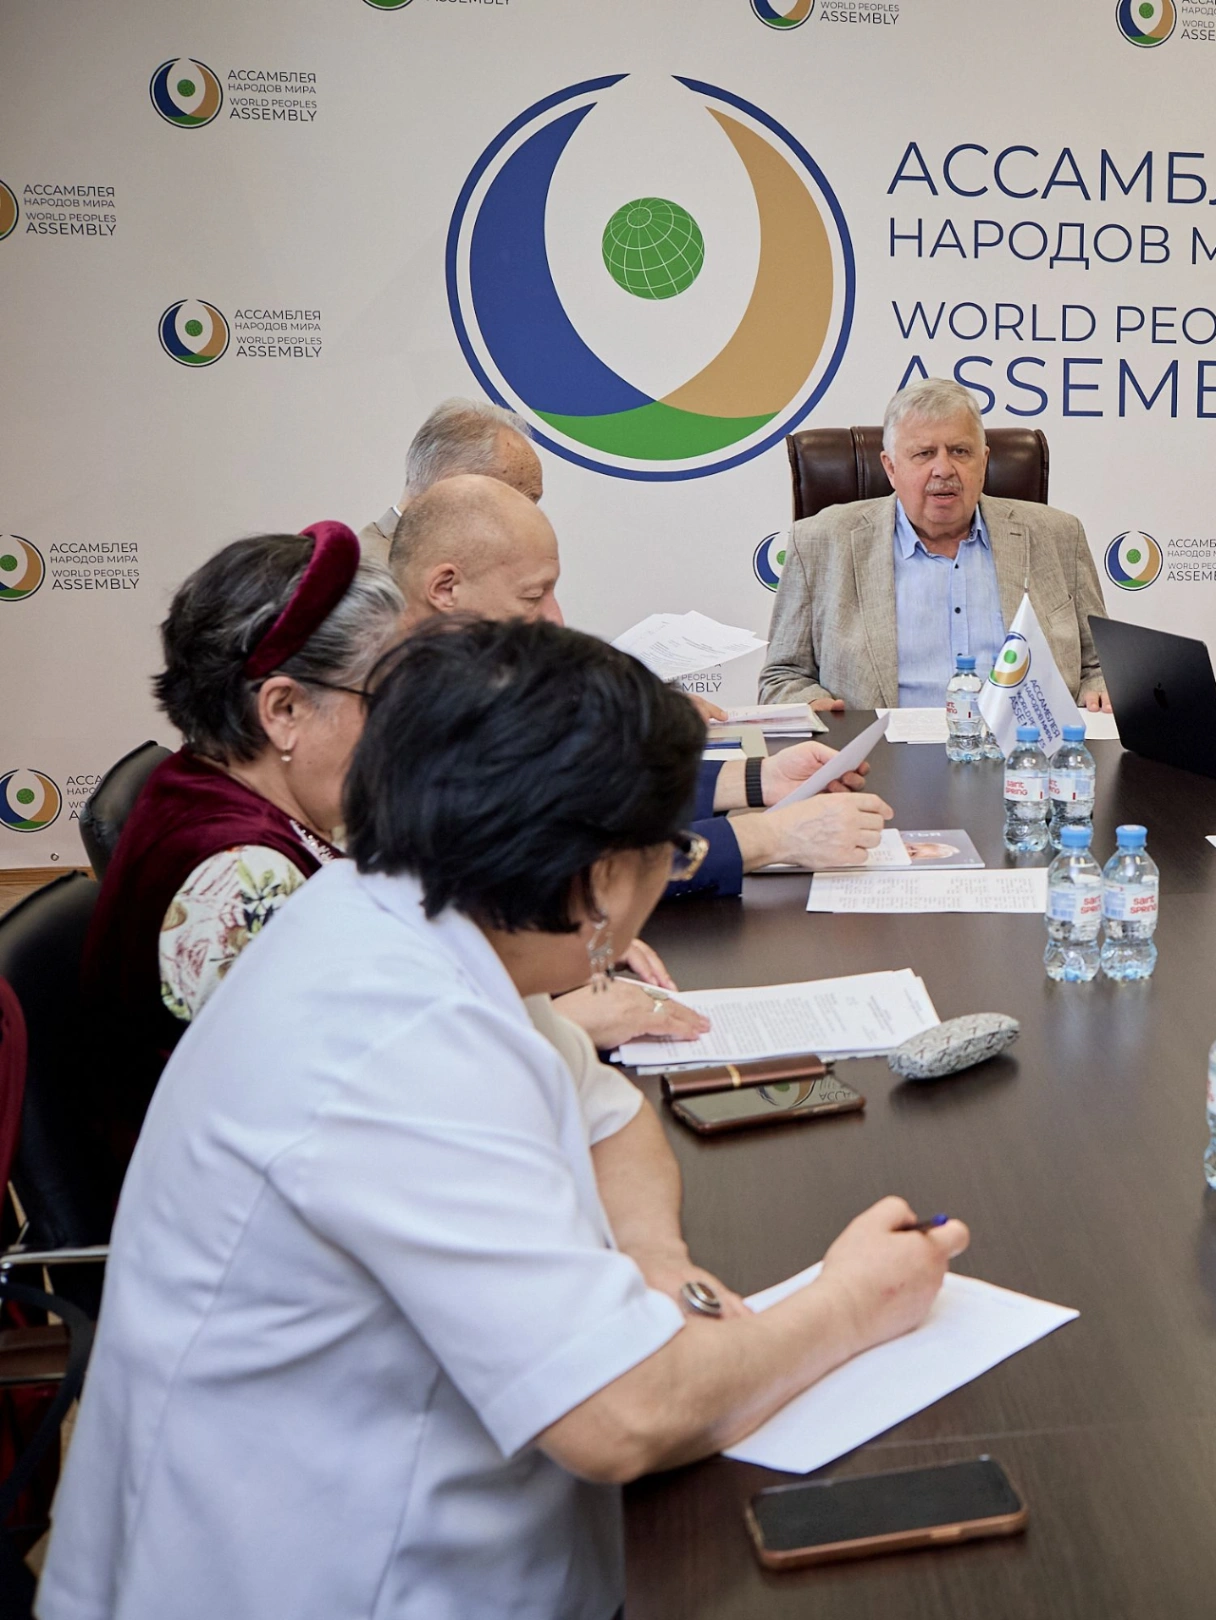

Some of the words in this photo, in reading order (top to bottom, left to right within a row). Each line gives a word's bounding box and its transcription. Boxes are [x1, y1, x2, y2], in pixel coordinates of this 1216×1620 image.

[820, 1, 856, 11] WORLD
[858, 2, 900, 13] PEOPLES
[819, 10, 900, 26] ASSEMBLY
[1181, 19, 1215, 29] WORLD
[227, 69, 317, 84] АССАМБЛЕЯ
[227, 82, 283, 94] НАРОДОВ
[284, 84, 317, 95] МИРА
[229, 97, 270, 108] WORLD
[271, 98, 318, 109] PEOPLES
[228, 106, 318, 122] ASSEMBLY
[22, 183, 116, 198] АССАМБЛЕЯ
[23, 197, 81, 208] НАРОДОВ
[82, 199, 116, 209] МИРА
[25, 212, 67, 222] WORLD
[68, 213, 117, 223] PEOPLES
[25, 221, 117, 237] ASSEMBLY
[889, 217, 1171, 271] НАРОДОВ
[233, 309, 321, 321] АССАМБЛЕЯ
[891, 300, 1097, 342] WORLD
[234, 321, 288, 332] НАРОДОВ
[290, 322, 322, 331] МИРА
[235, 335, 276, 345] WORLD
[276, 336, 323, 346] PEOPLES
[235, 344, 323, 358] ASSEMBLY
[49, 542, 139, 554] АССАМБЛЕЯ
[1167, 549, 1212, 559] НАРОДОВ
[49, 555, 105, 565] НАРОДОВ
[106, 555, 139, 564] МИРА
[1167, 562, 1200, 570] WORLD
[51, 569, 92, 578] WORLD
[93, 568, 140, 578] PEOPLES
[51, 577, 140, 591] ASSEMBLY
[681, 673, 722, 681] PEOPLES
[1029, 679, 1061, 738] АССАМБЛЕЯ
